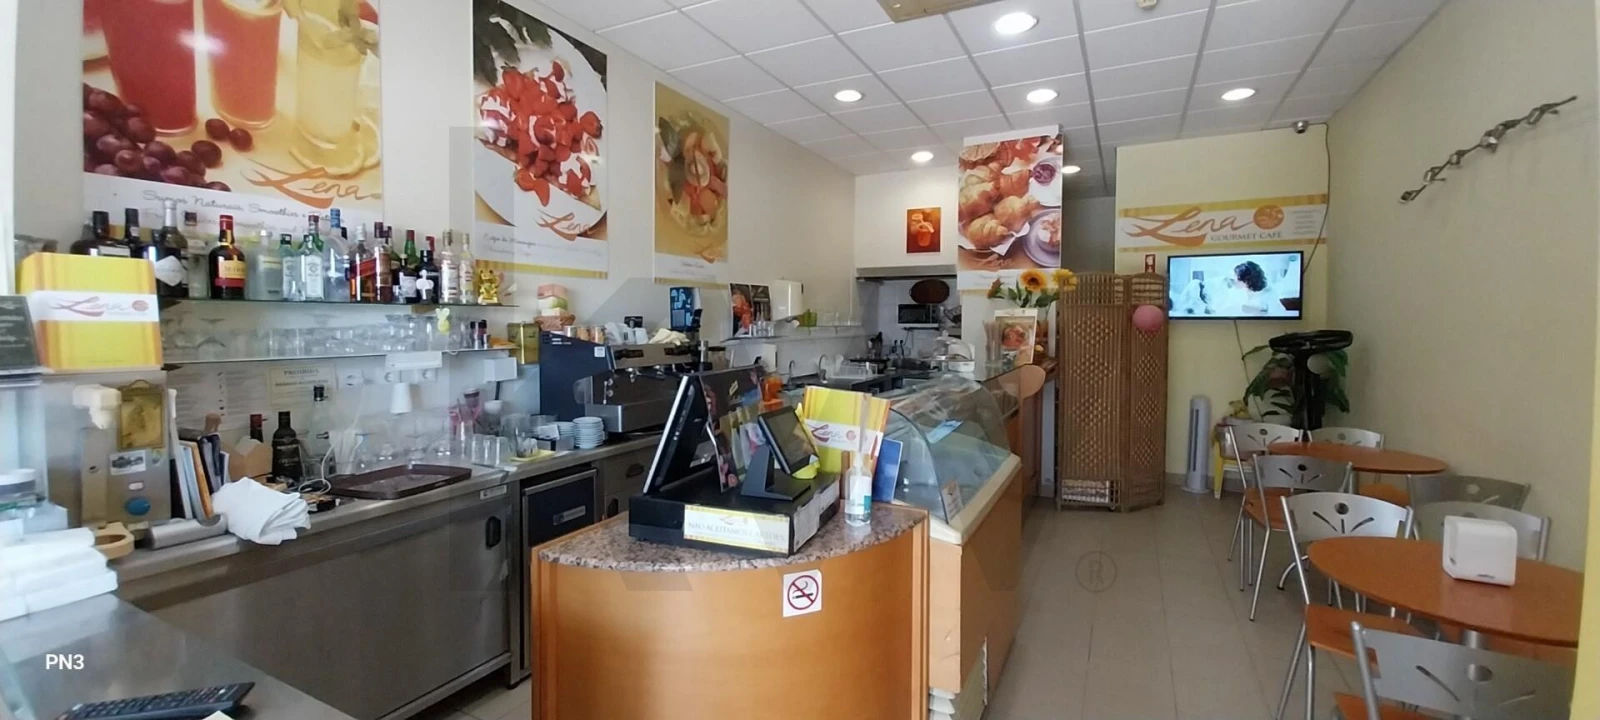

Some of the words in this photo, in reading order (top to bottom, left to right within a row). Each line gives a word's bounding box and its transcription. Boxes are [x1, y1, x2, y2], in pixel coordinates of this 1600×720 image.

[241, 157, 381, 209] Lena
[534, 208, 592, 241] Lena
[1121, 206, 1254, 247] Lena
[1211, 232, 1257, 242] GOURMET
